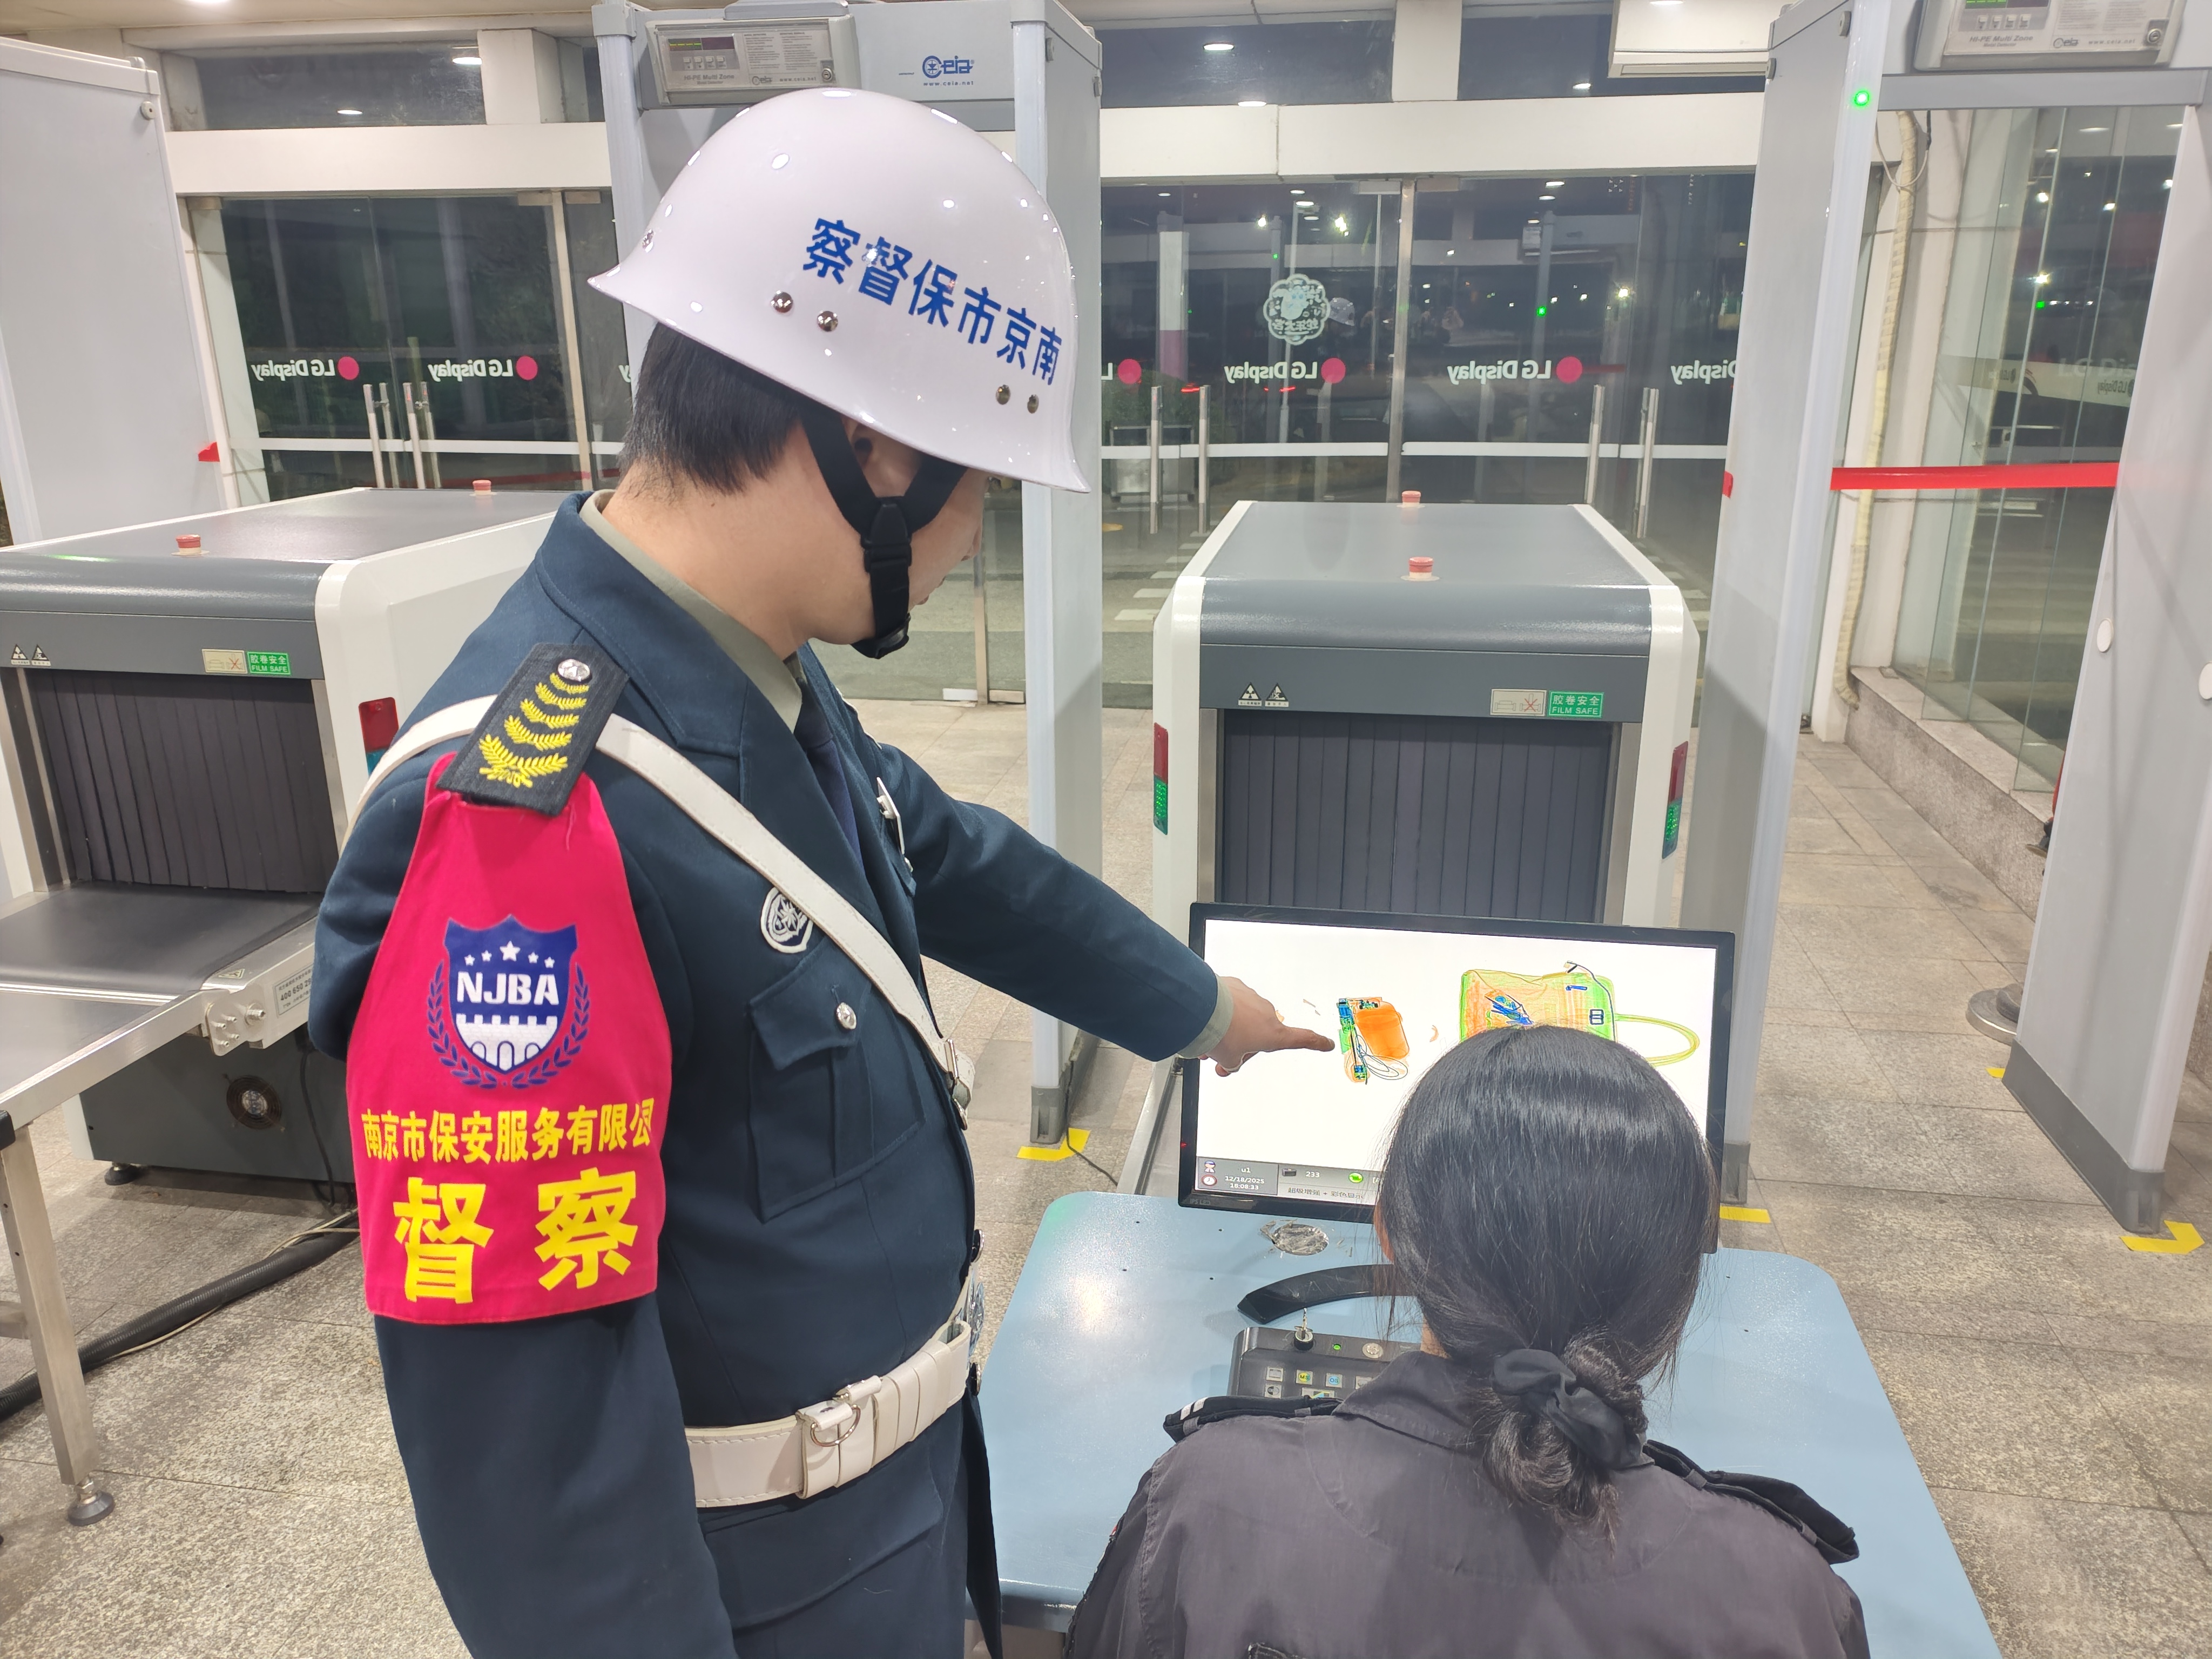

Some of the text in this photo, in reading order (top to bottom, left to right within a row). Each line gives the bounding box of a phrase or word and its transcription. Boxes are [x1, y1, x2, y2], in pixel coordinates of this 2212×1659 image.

[250, 654, 286, 664] 胶卷安全
[1553, 694, 1600, 706] 胶卷安全
[456, 972, 559, 1005] NJBA
